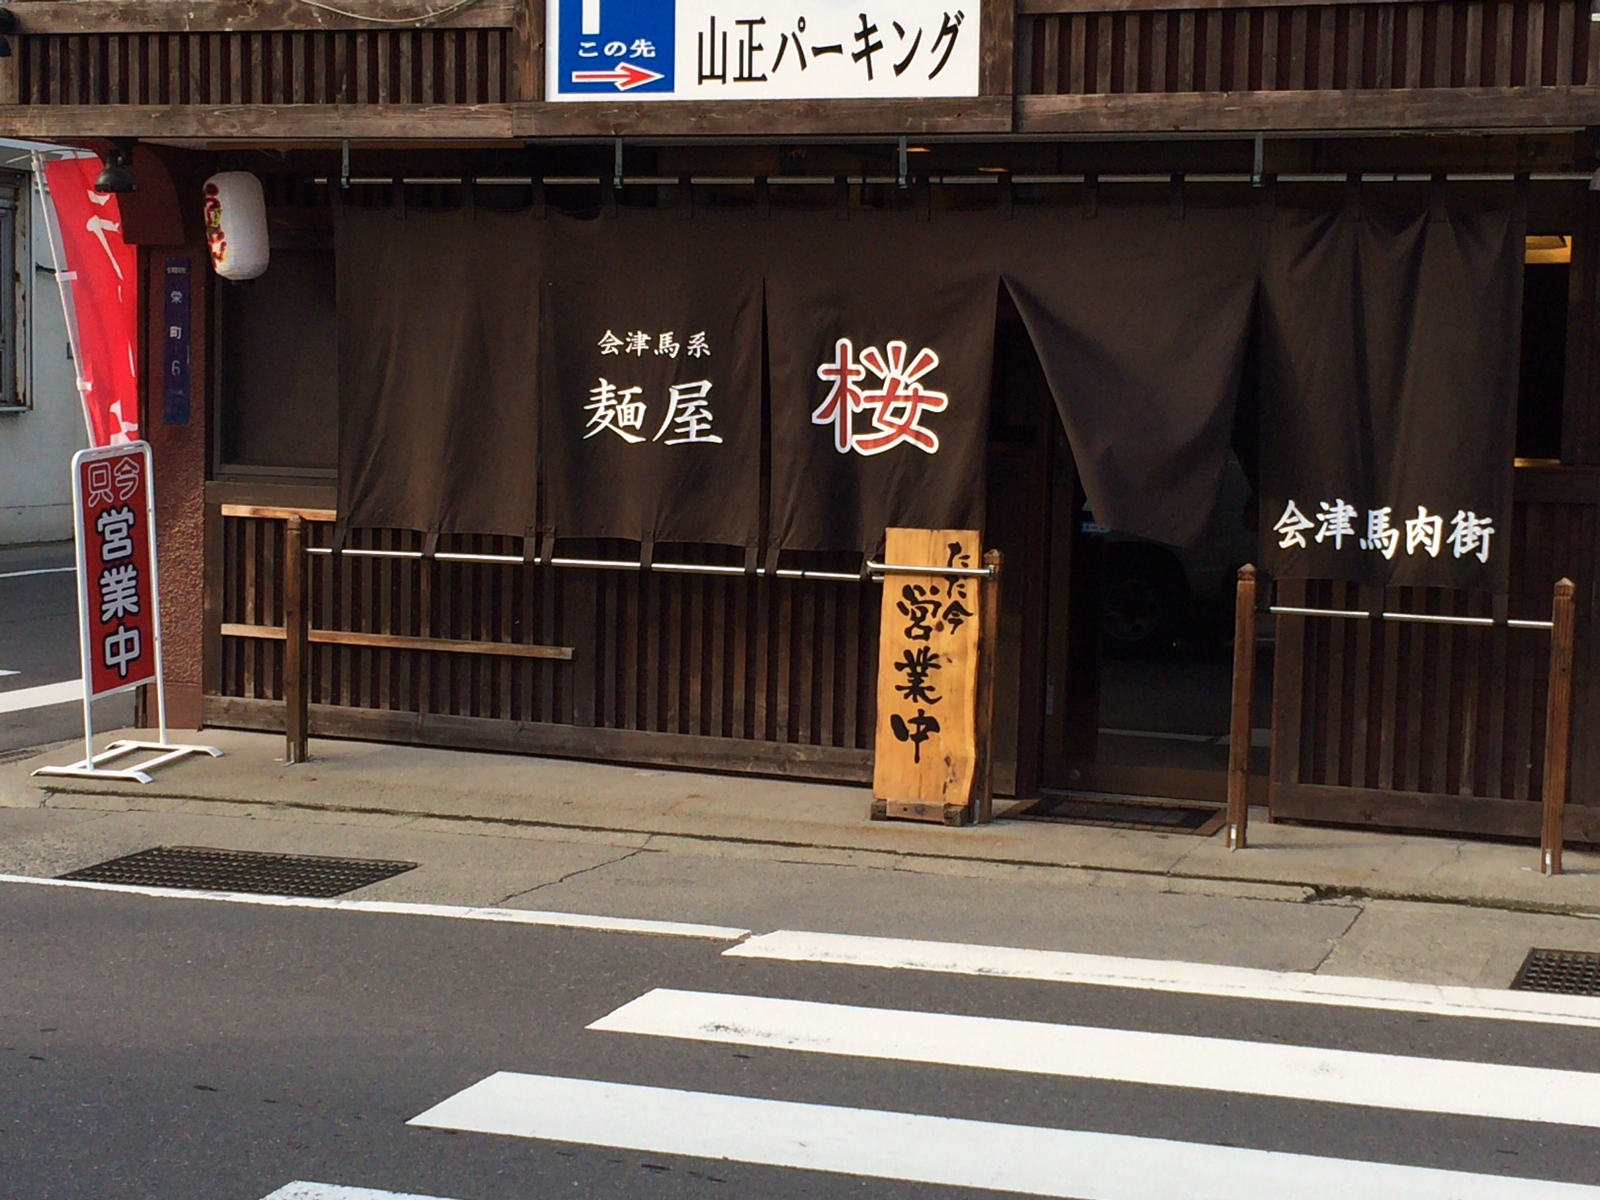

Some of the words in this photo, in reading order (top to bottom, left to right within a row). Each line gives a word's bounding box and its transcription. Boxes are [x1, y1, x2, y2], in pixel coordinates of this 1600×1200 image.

[578, 39, 656, 58] この先
[697, 10, 965, 86] 山正パーキング
[597, 329, 711, 359] 会津馬系
[582, 377, 723, 446] 麺屋
[811, 338, 949, 456] 桜
[88, 456, 140, 508] 只今
[1272, 498, 1496, 564] 会津馬肉街
[96, 505, 142, 678] 営業中
[890, 584, 943, 764] 営業中
